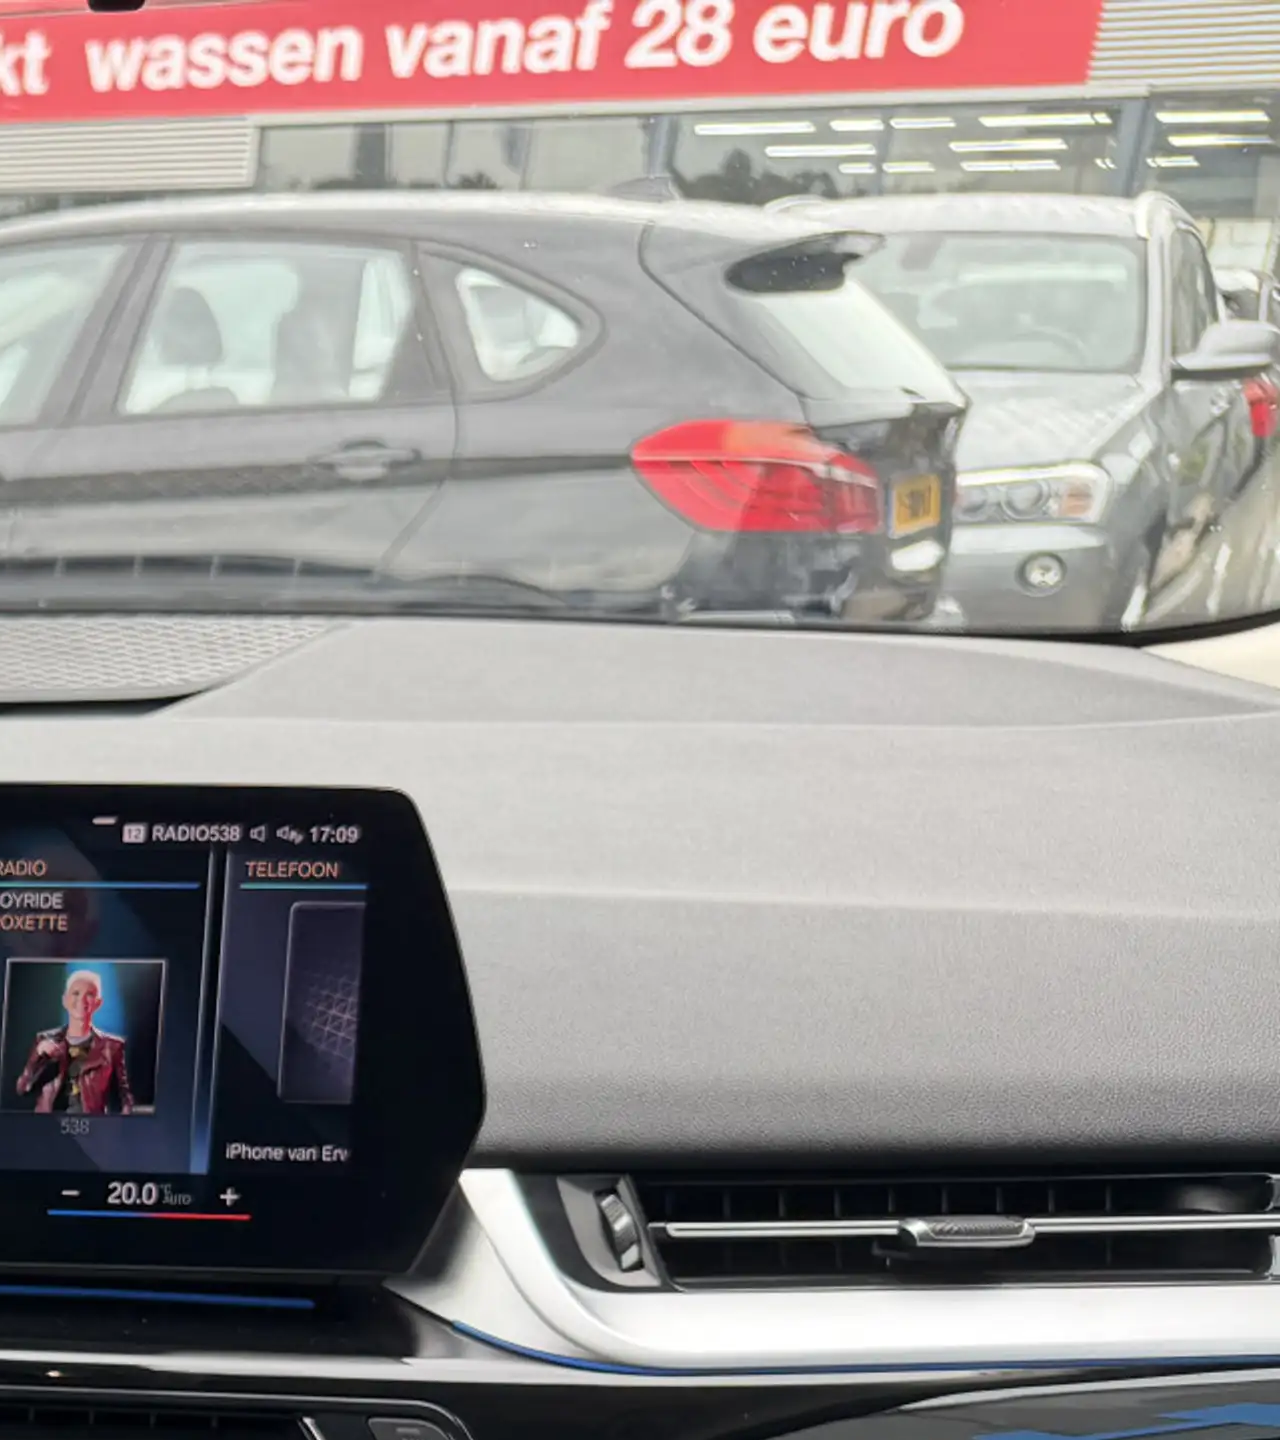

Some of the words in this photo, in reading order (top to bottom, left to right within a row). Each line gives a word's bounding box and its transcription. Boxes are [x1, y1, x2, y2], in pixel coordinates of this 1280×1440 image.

[85, 26, 366, 92] wassen
[384, 0, 611, 79] vanaf
[624, 0, 734, 68] 28
[752, 0, 964, 62] euro
[309, 826, 359, 843] 17:09
[245, 861, 338, 878] TELEFOON
[225, 1142, 283, 1161] iPhone
[287, 1146, 318, 1161] van
[107, 1182, 158, 1205] 20.0
